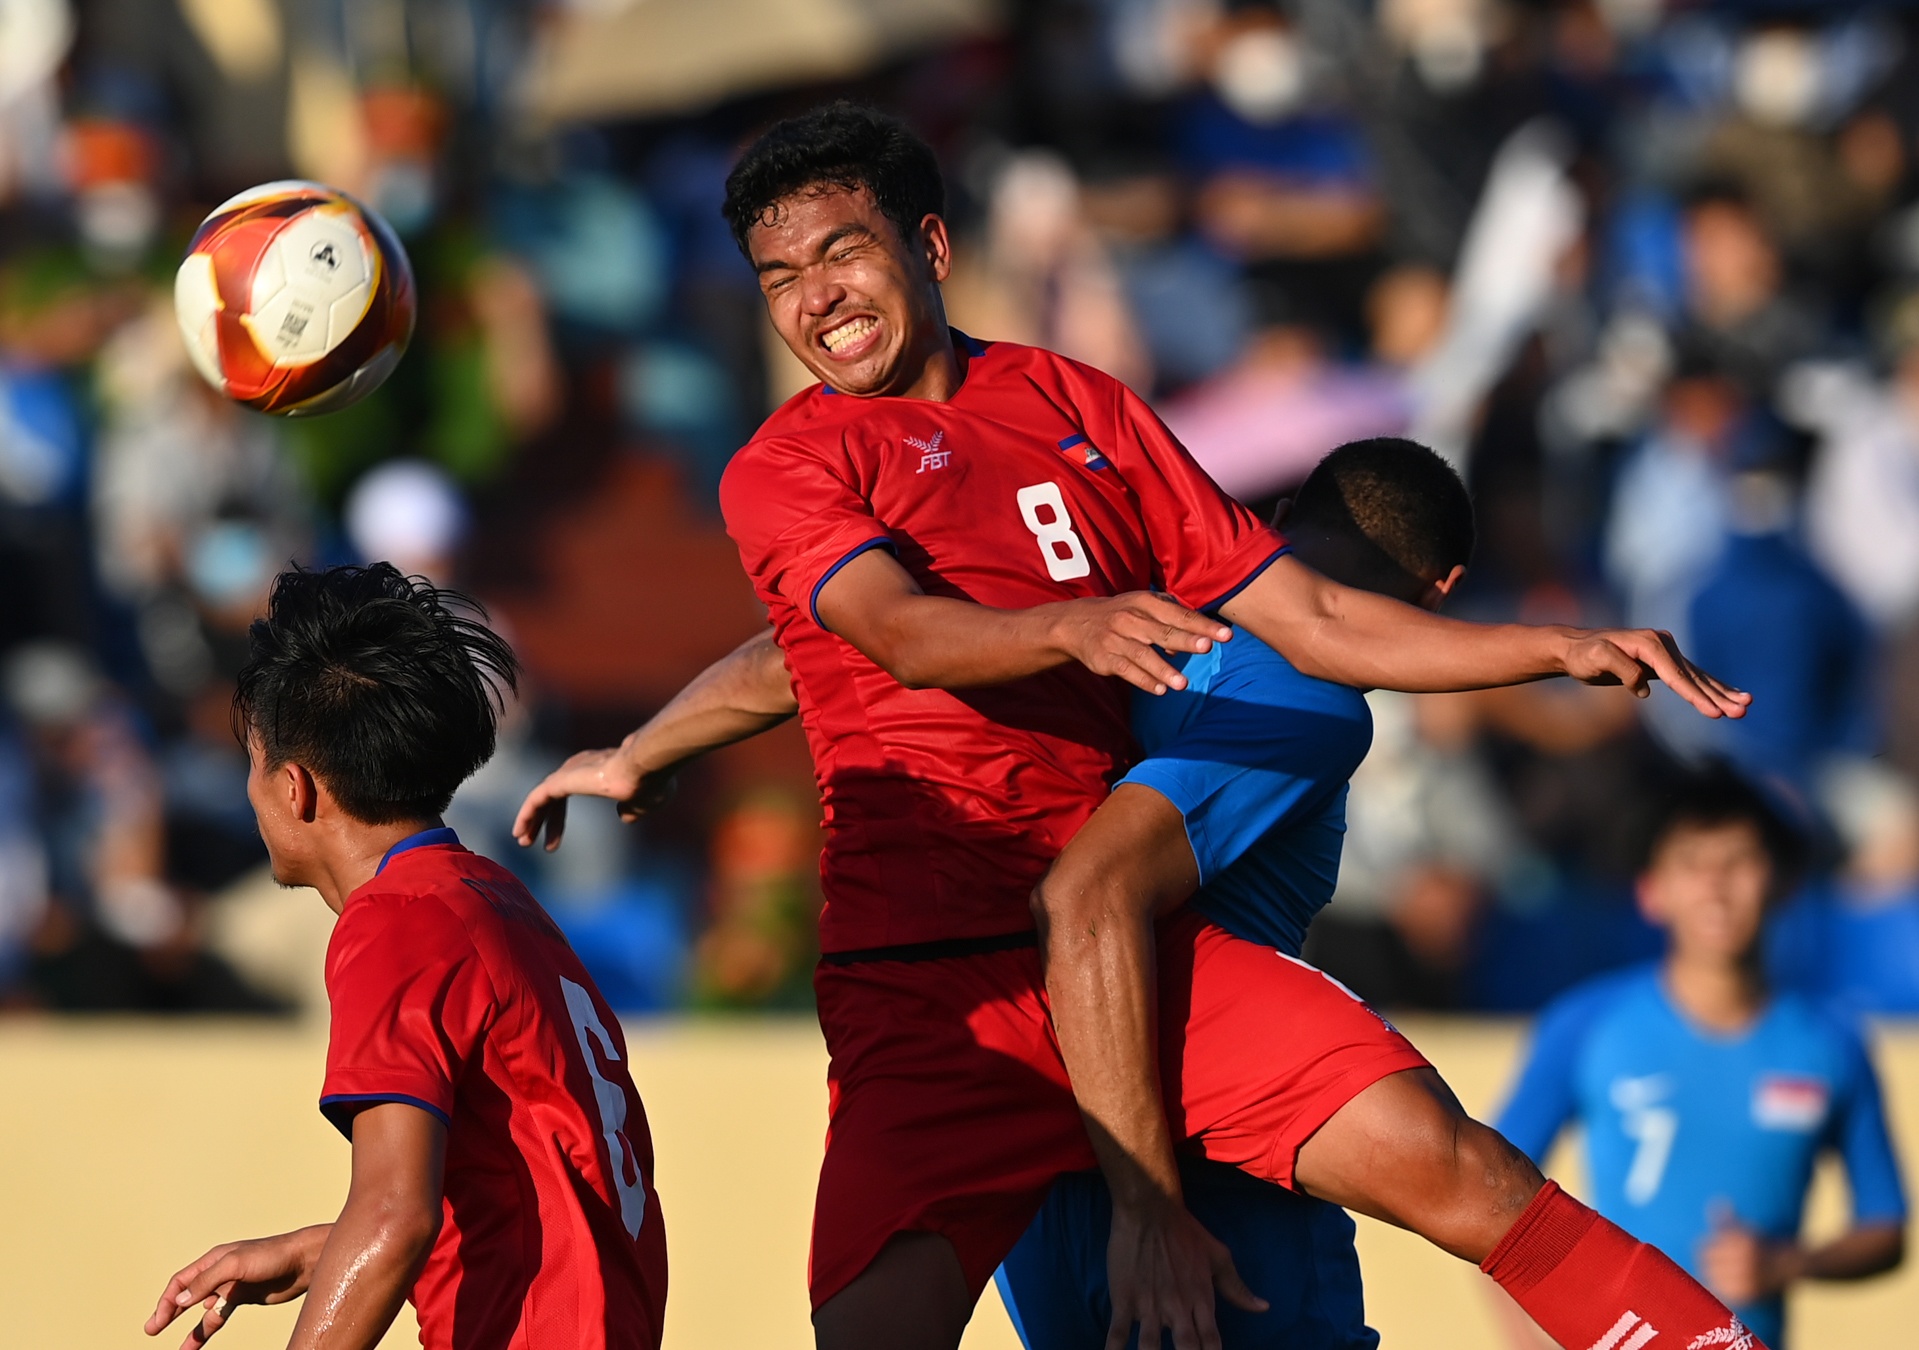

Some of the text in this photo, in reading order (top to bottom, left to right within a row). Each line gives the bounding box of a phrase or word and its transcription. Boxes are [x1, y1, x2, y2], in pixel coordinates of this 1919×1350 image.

[916, 451, 952, 474] FBT
[1016, 481, 1091, 582] 8
[559, 974, 647, 1242] 6
[1621, 1107, 1678, 1206] 7
